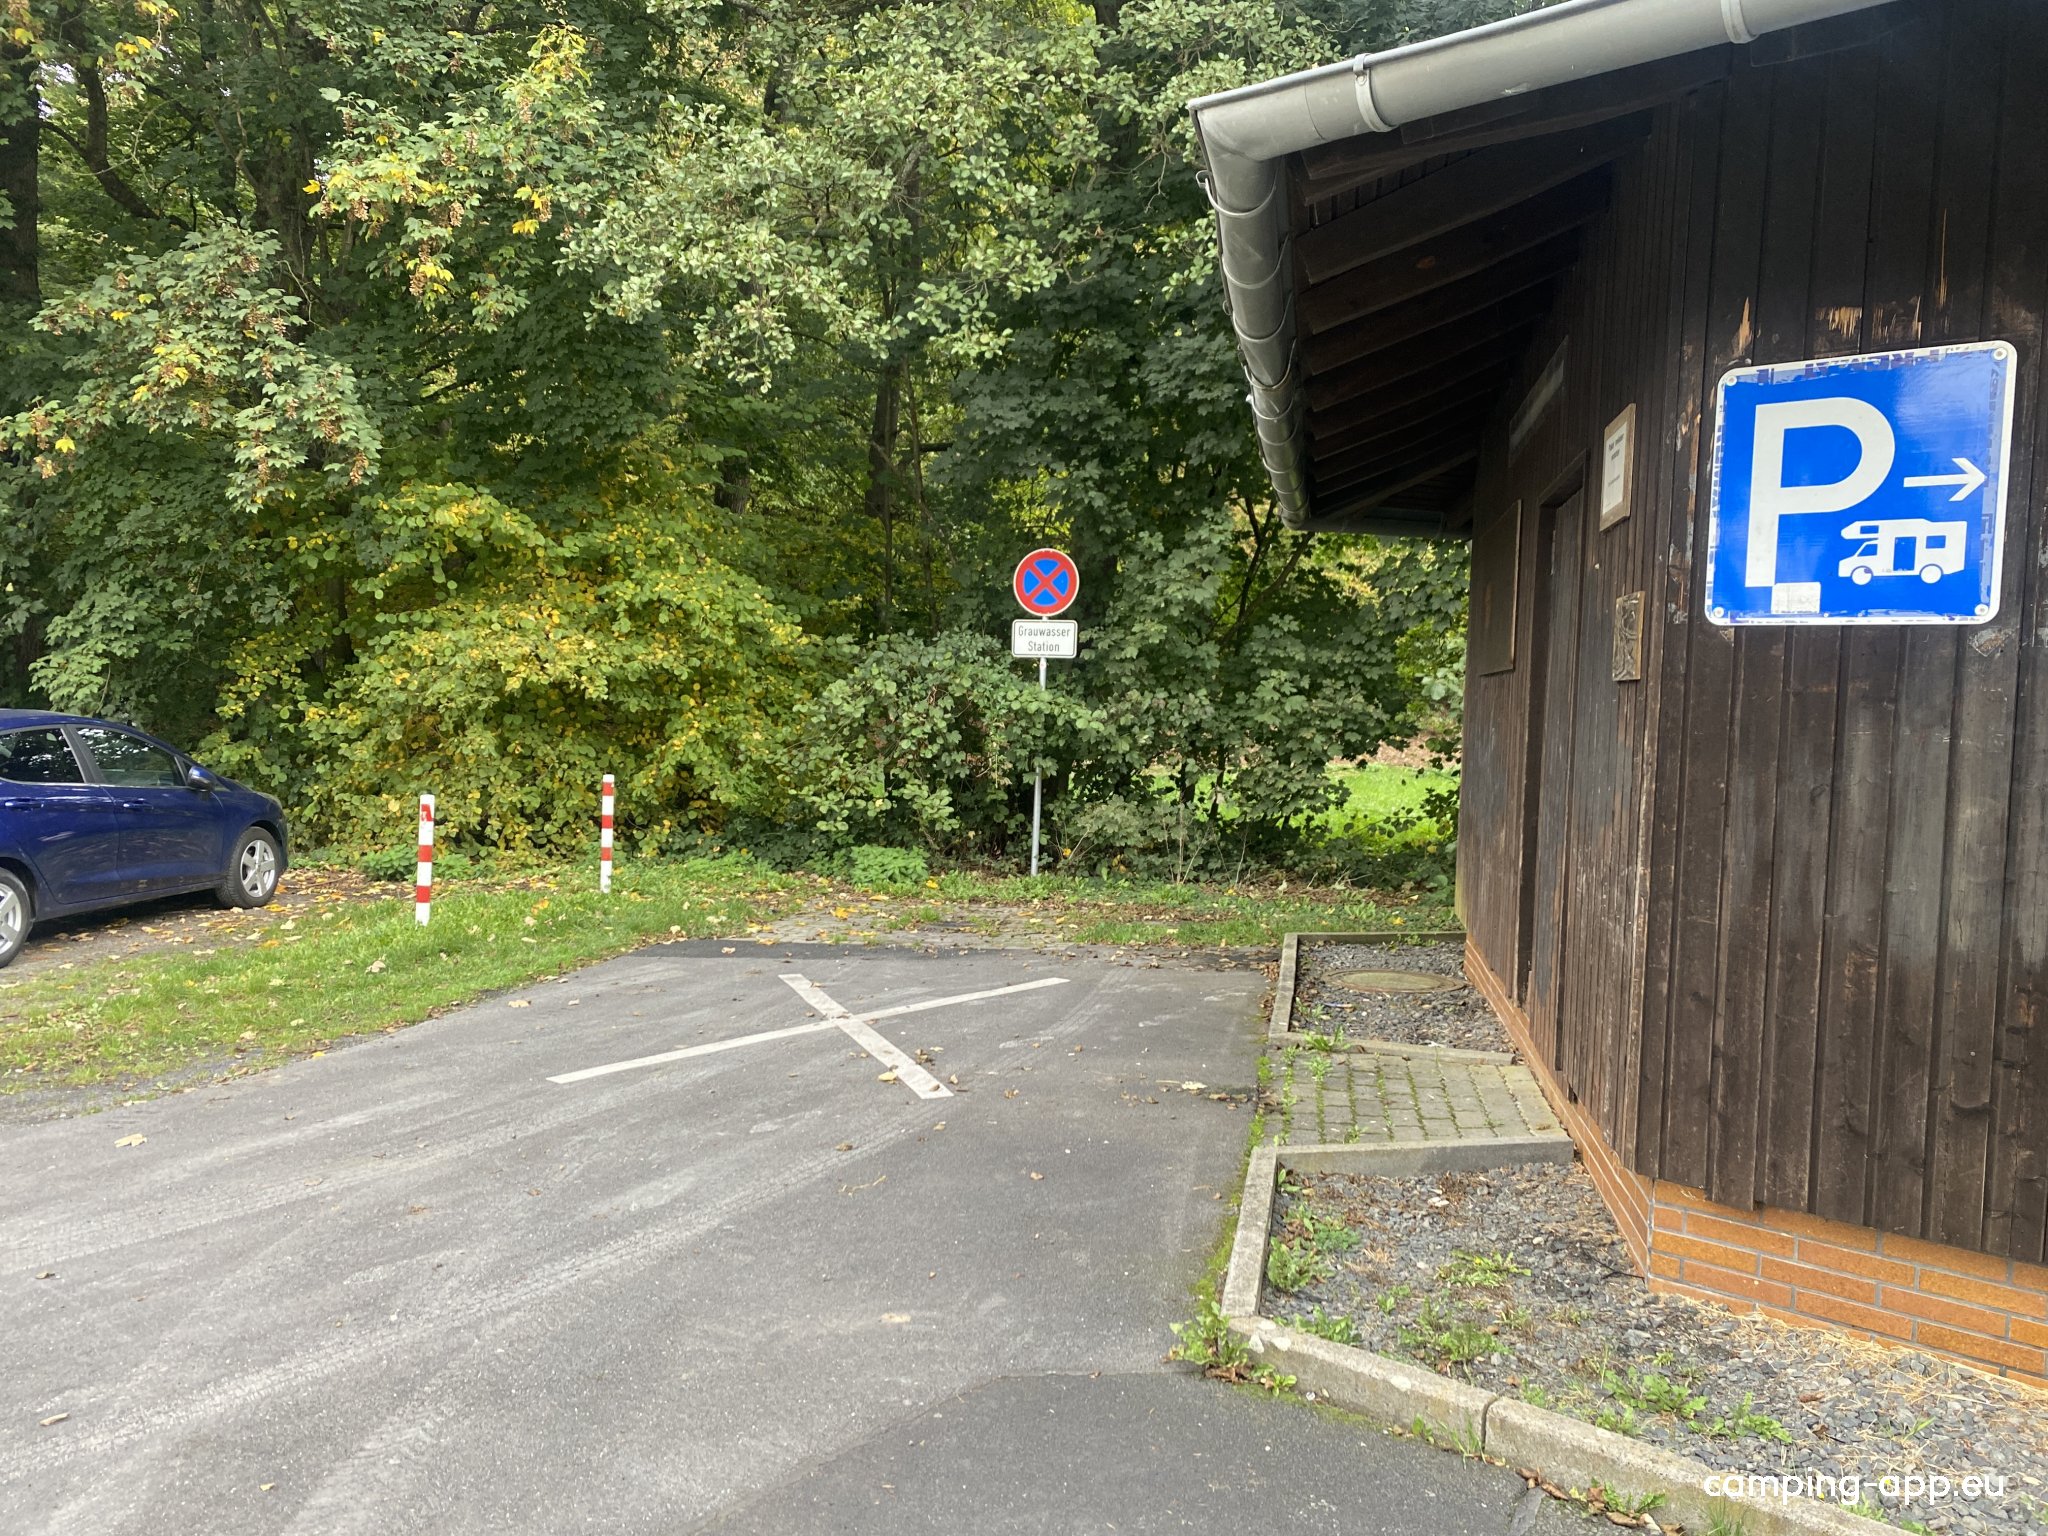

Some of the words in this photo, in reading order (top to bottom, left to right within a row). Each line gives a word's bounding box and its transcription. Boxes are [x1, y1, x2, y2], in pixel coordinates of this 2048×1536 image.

[1745, 397, 1896, 588] P
[1018, 625, 1071, 637] Grauwasser
[1028, 641, 1060, 652] Station
